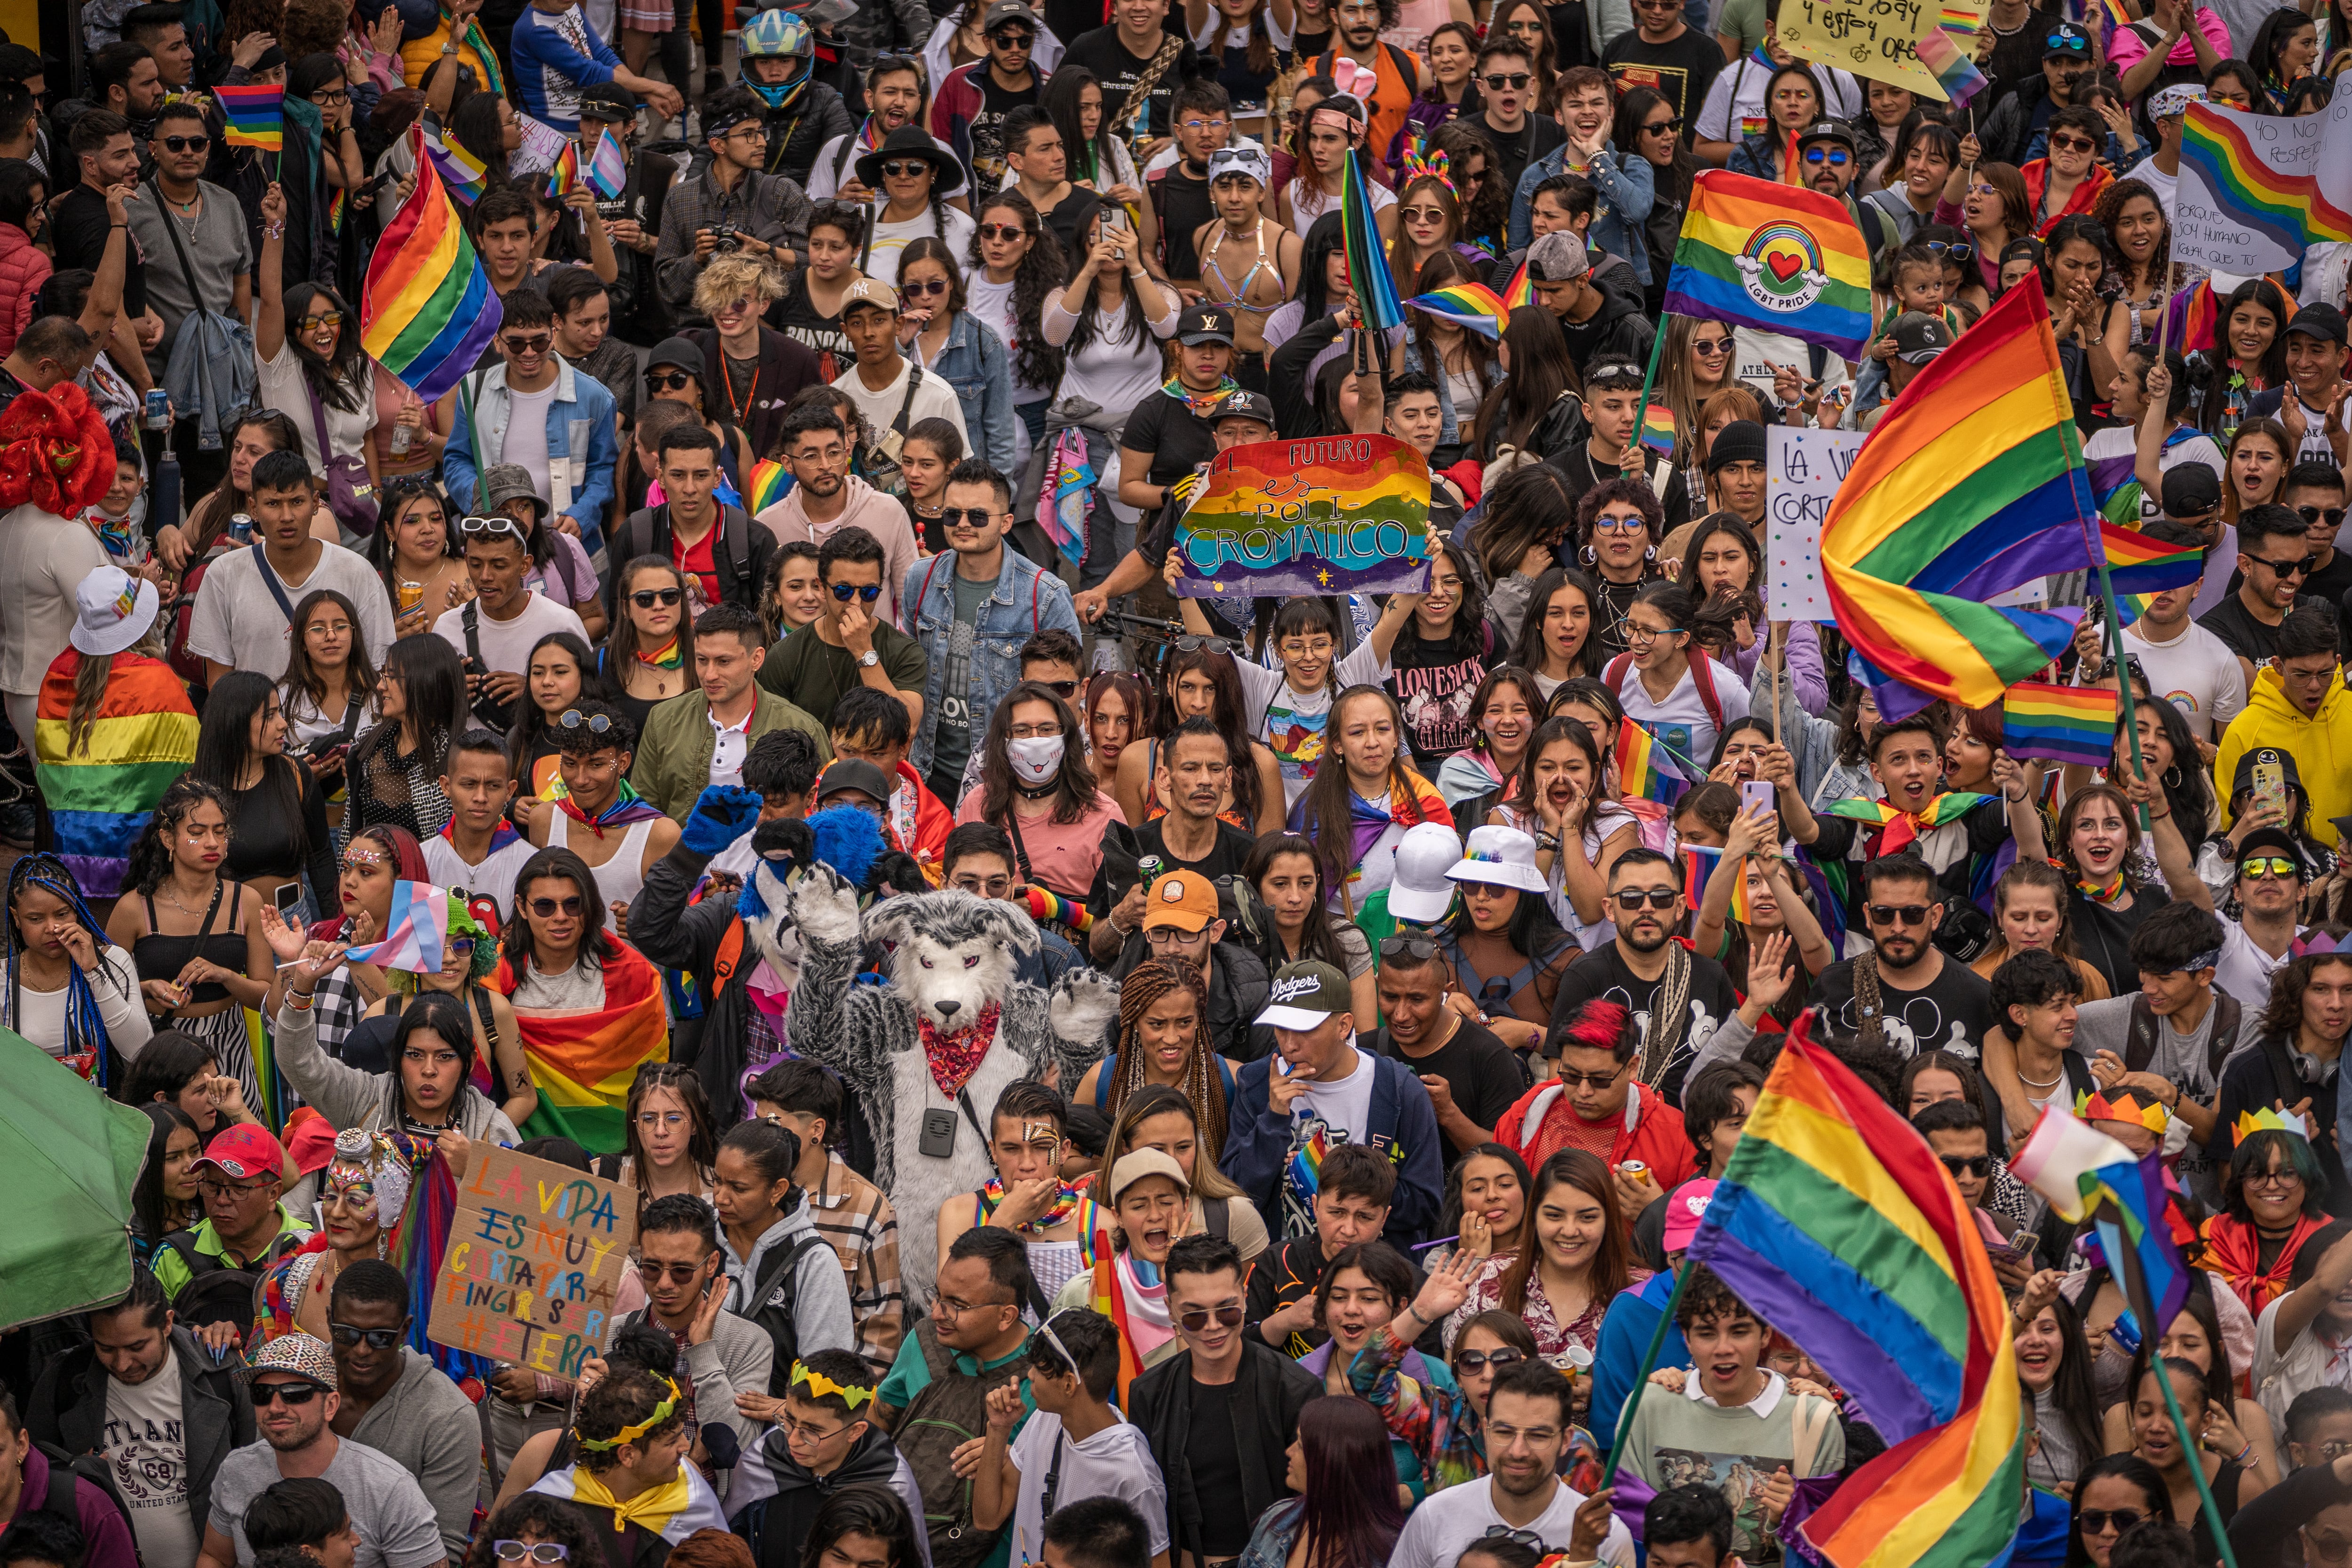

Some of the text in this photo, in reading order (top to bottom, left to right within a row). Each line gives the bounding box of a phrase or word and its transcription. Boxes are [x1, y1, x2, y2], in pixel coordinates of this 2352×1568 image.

[1102, 81, 1135, 91] threate
[2256, 119, 2317, 141] YO NO
[2176, 203, 2224, 224] PORQUE
[2174, 222, 2251, 248] SOY HUMANO
[2208, 250, 2233, 268] QUE
[1748, 282, 1811, 309] LGBT PRIDE
[1211, 438, 1370, 475] EL FUTURO
[1785, 442, 1809, 484] LA
[1255, 472, 1329, 498] es
[1185, 519, 1408, 568] CROMÁTICO
[1392, 654, 1486, 698] LOVESICK
[1271, 974, 1321, 1002] Dodgers
[468, 1156, 620, 1234] LA VIDA
[475, 1206, 618, 1278] ES MUY
[451, 1242, 614, 1304] CORTA PARA
[548, 1298, 605, 1339] SER
[145, 1463, 172, 1484] 68
[129, 1497, 163, 1509] UNITED
